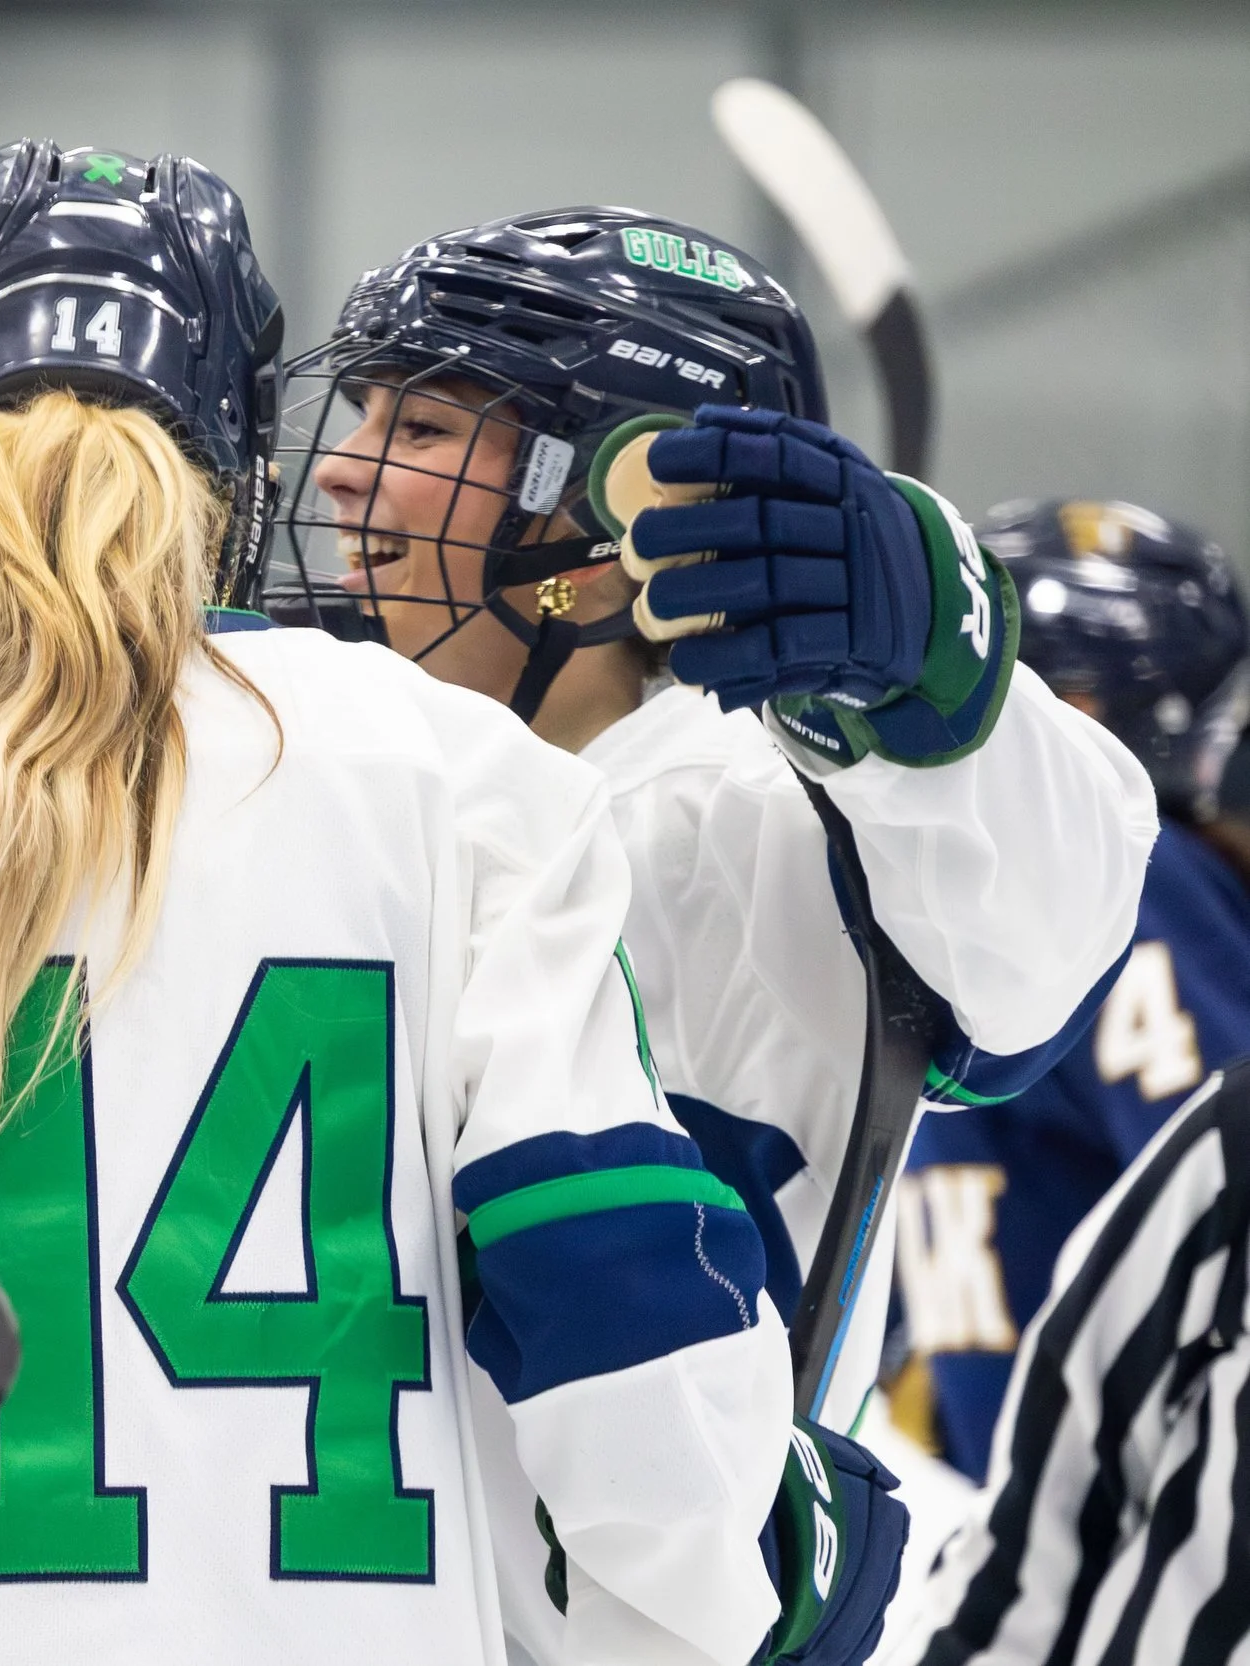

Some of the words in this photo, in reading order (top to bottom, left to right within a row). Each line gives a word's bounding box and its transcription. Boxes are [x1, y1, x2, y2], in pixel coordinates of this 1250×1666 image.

[620, 227, 744, 293] GULLS
[51, 296, 122, 357] 14
[246, 454, 265, 564] BAUER
[1096, 939, 1204, 1102] 4
